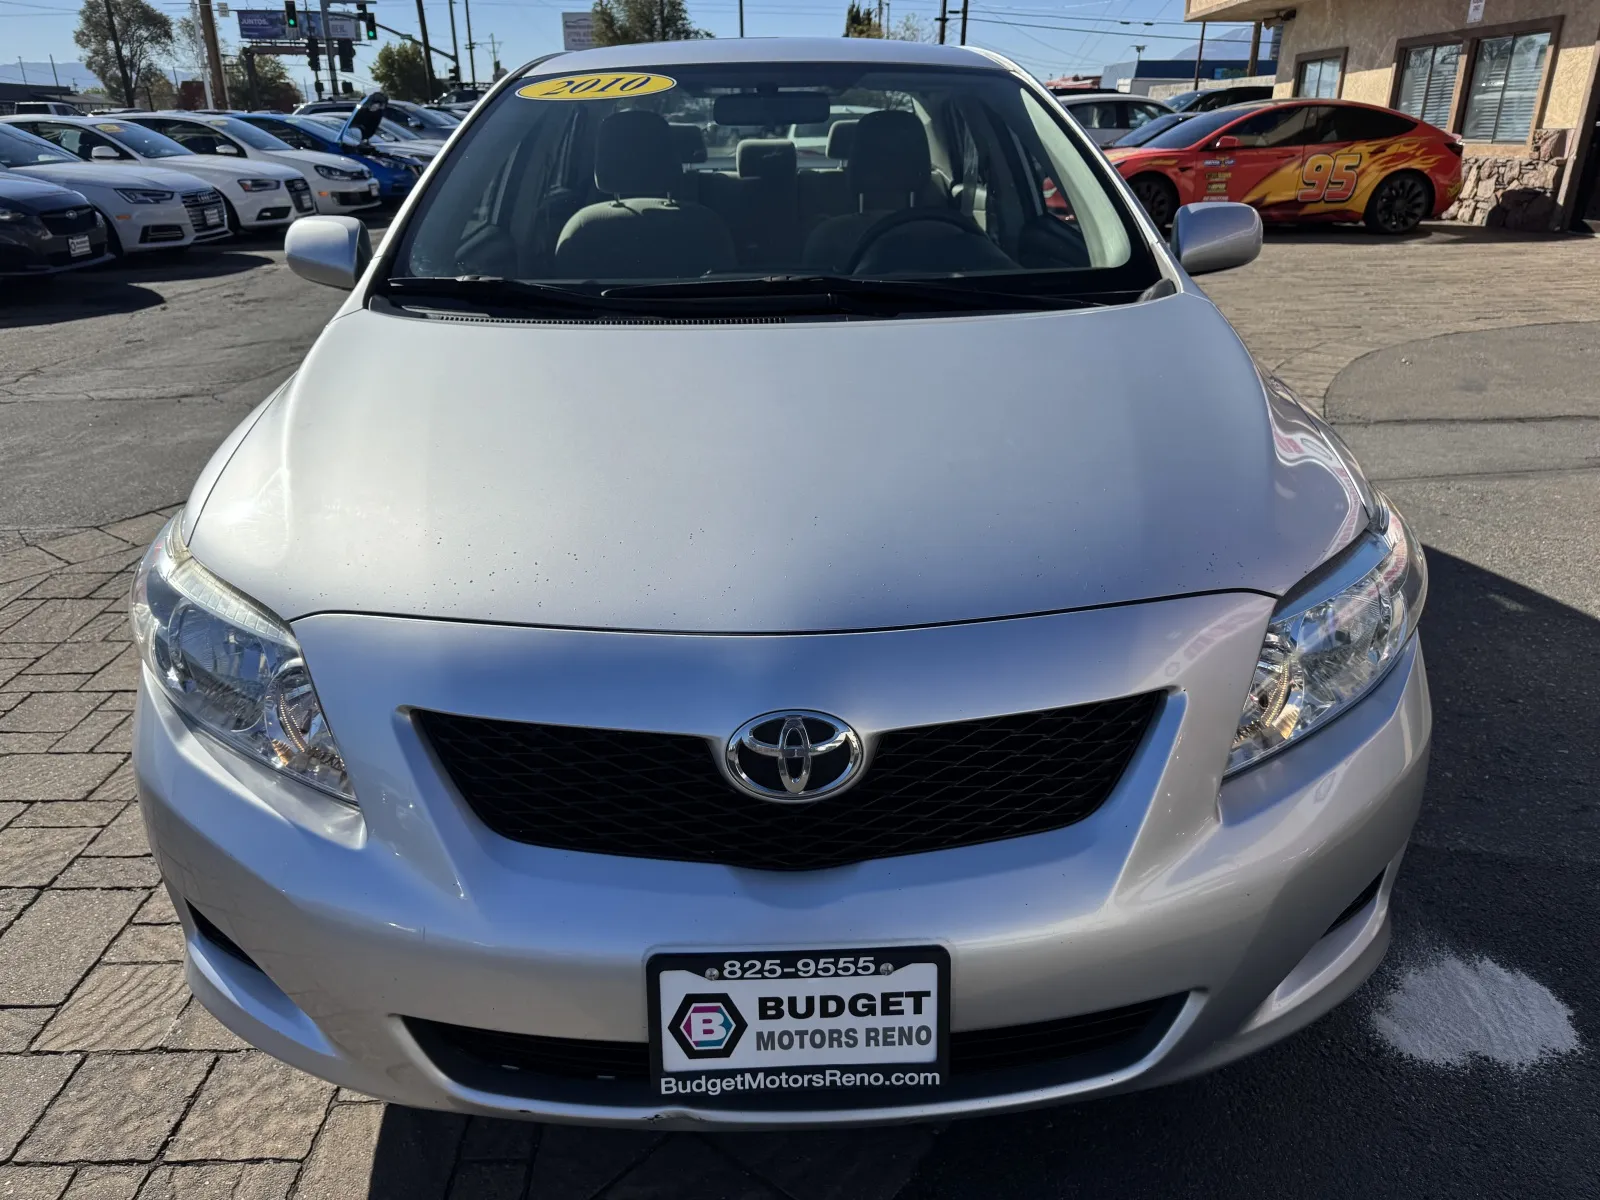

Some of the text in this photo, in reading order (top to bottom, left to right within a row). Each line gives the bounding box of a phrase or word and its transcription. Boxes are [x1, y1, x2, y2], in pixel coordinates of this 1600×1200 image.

[541, 76, 651, 96] 2010
[1298, 153, 1362, 203] 95
[723, 957, 875, 979] 825-9555
[758, 990, 932, 1021] BUDGET
[756, 1025, 933, 1052] MOTORS RENO
[660, 1069, 941, 1096] BudgetMotorsReno.com
